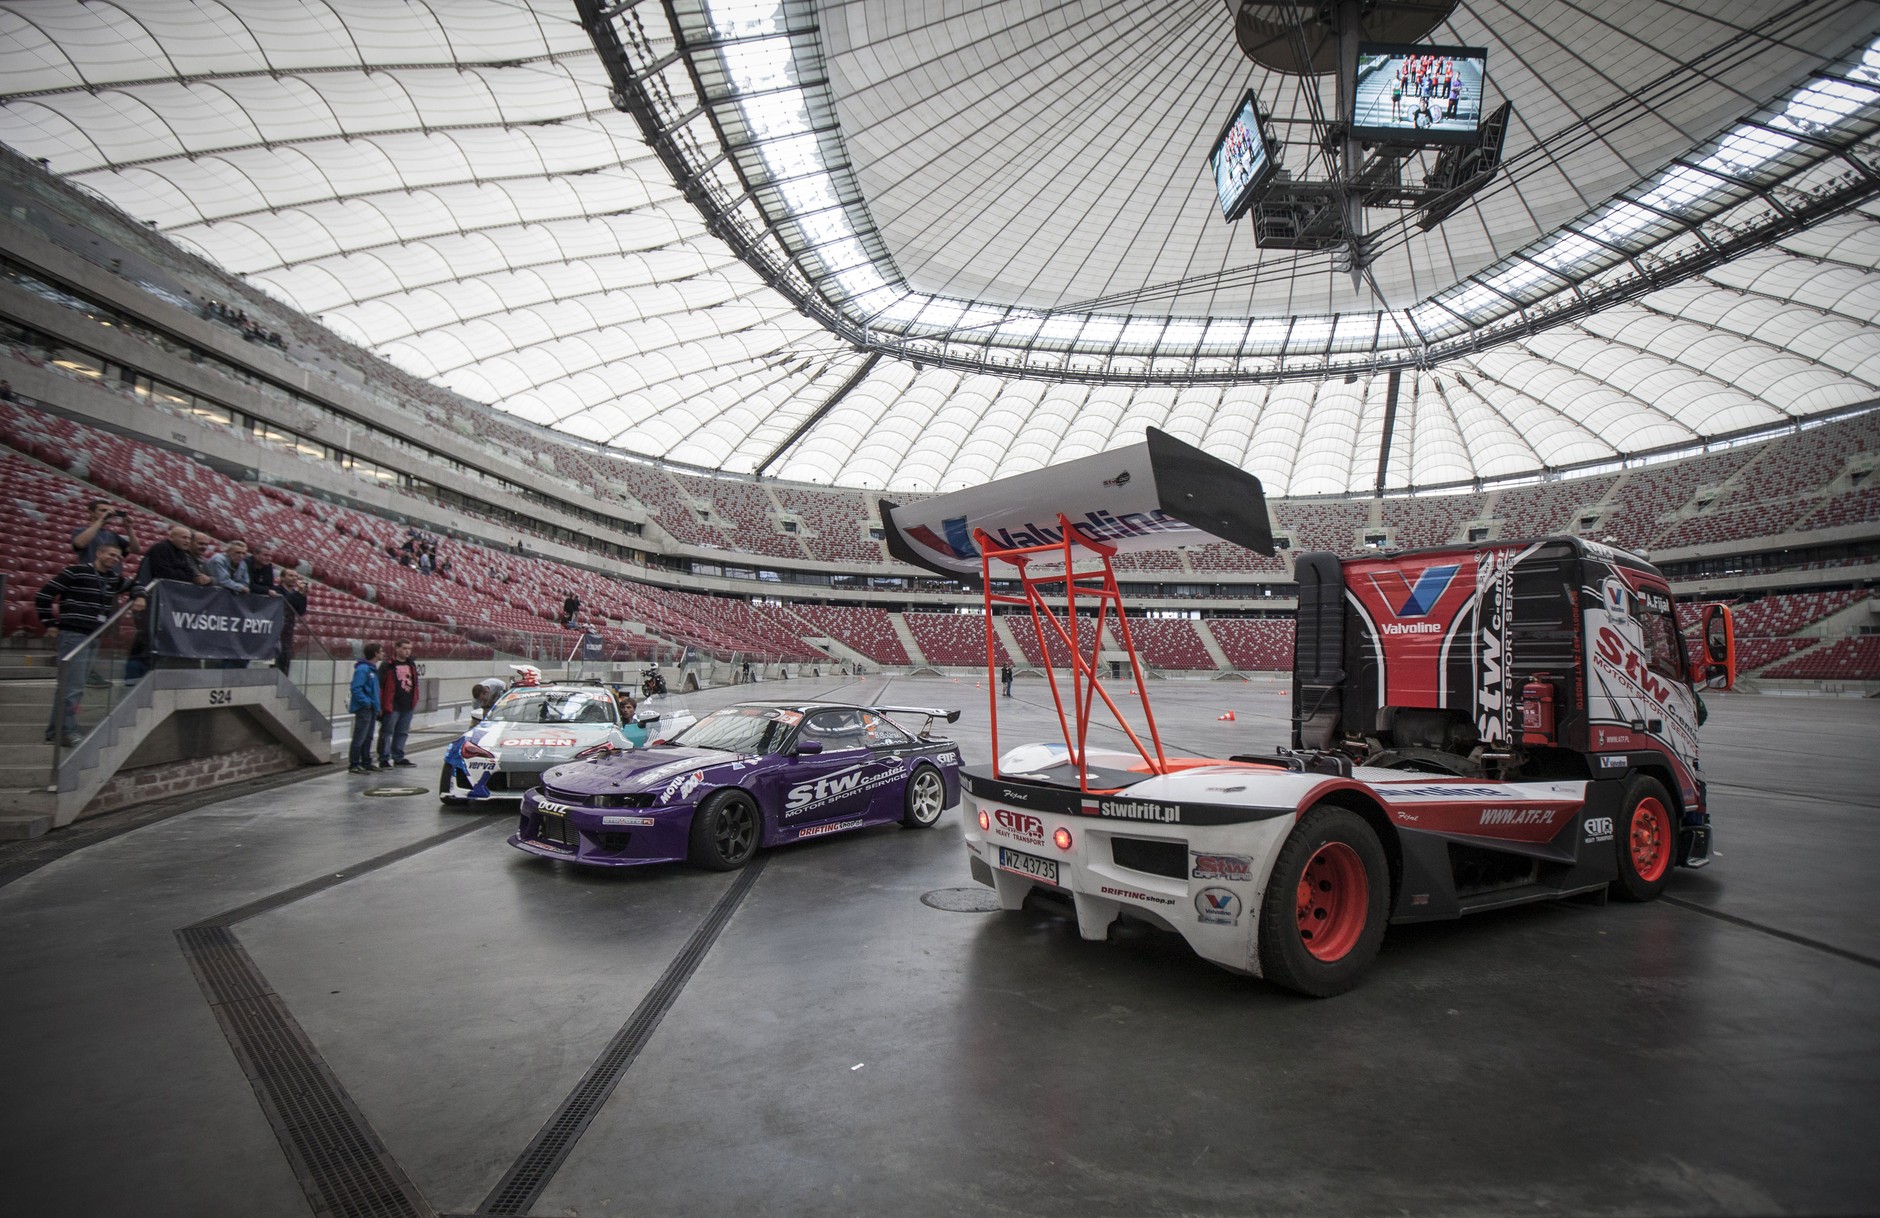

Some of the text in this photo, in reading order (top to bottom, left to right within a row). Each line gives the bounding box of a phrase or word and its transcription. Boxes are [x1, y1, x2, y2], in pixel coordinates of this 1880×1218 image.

[171, 610, 228, 631] WYJŚCIE
[230, 617, 241, 632] Z
[1382, 621, 1442, 635] Valvoline
[1505, 547, 1517, 744] OTOR SPORT SERVICE
[209, 690, 231, 704] S24
[1593, 655, 1634, 693] MOTOR
[1635, 691, 1668, 722] SPORT
[1668, 703, 1698, 742] C-ente
[502, 738, 573, 747] ORLEN
[468, 761, 496, 771] verva
[660, 775, 686, 804] MOTUL
[785, 772, 908, 818] MOTOR SPORT SERVICE
[537, 800, 571, 814] DOTZ
[1101, 801, 1181, 823] stwdrift.pl
[1479, 809, 1556, 825] WWW.ATF.PL
[995, 828, 1045, 847] HEAVY TRANSPORT
[1005, 850, 1056, 880] WZ 43735
